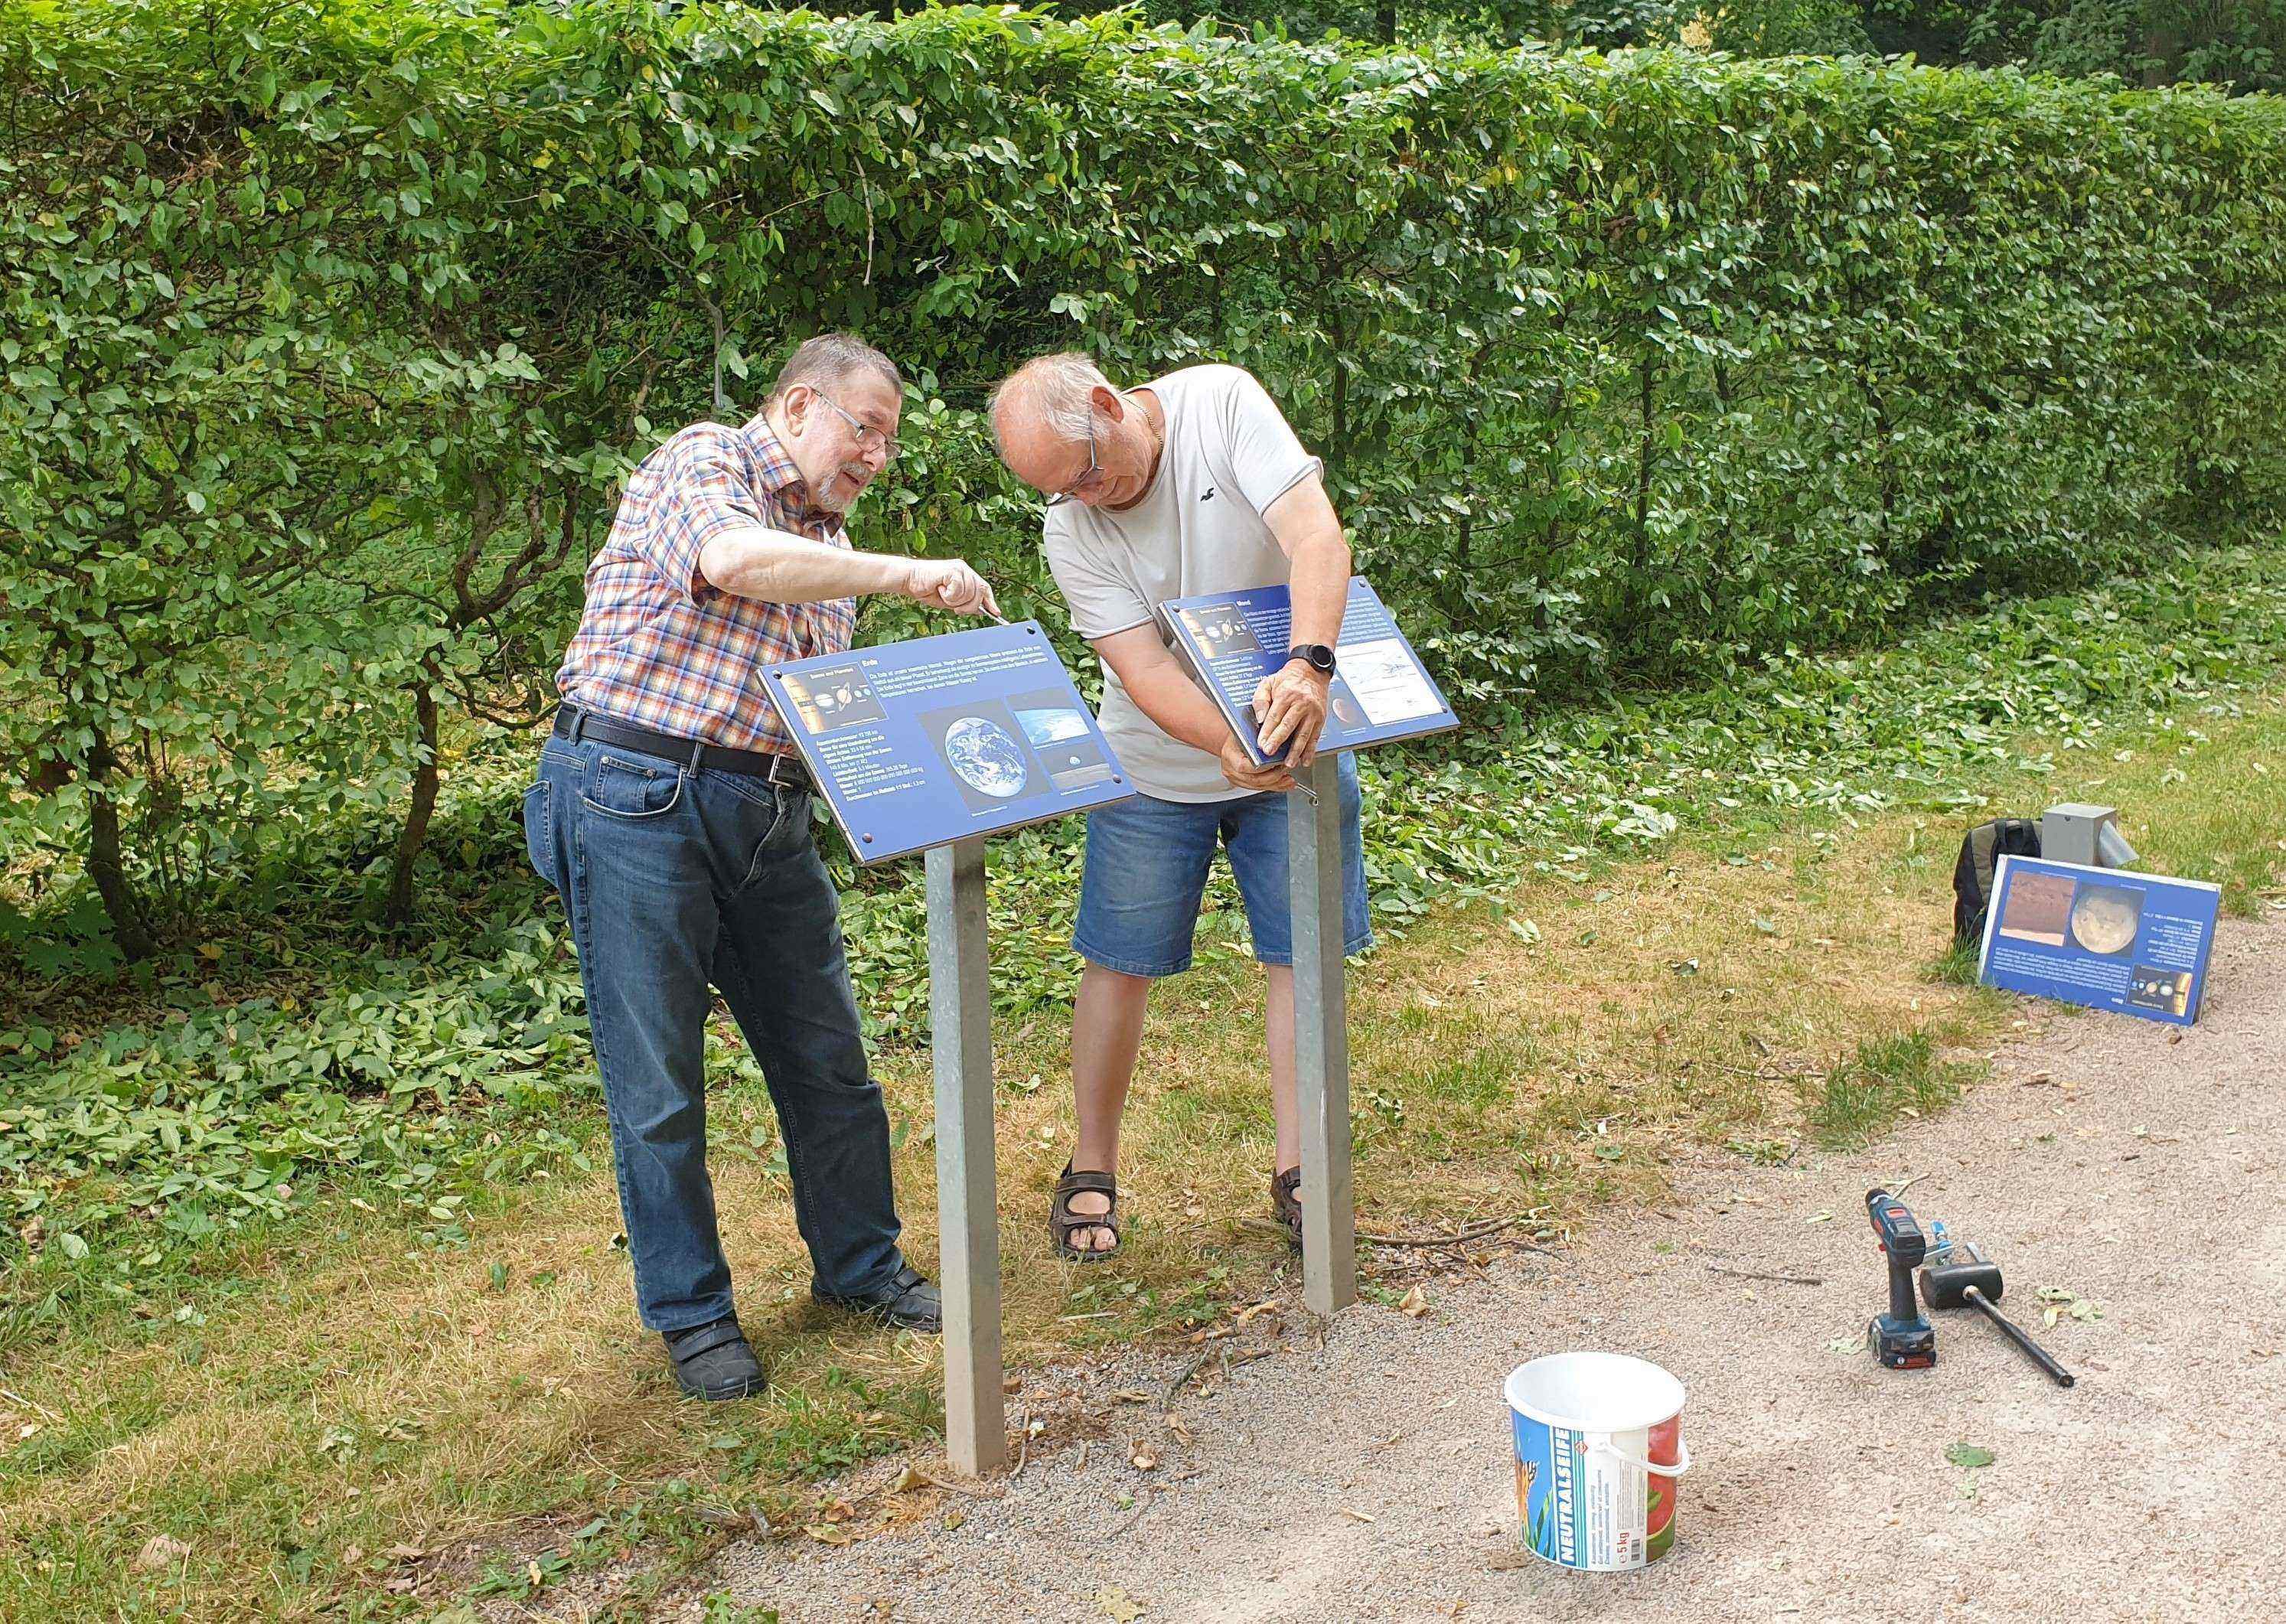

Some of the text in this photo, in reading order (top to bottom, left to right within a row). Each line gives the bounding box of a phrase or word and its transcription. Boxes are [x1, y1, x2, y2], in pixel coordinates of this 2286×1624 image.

[861, 659, 879, 667] Erde
[1555, 1428, 1575, 1562] NEUTRALSEIFE
[1617, 1532, 1630, 1544] kg
[1617, 1544, 1628, 1554] 5
